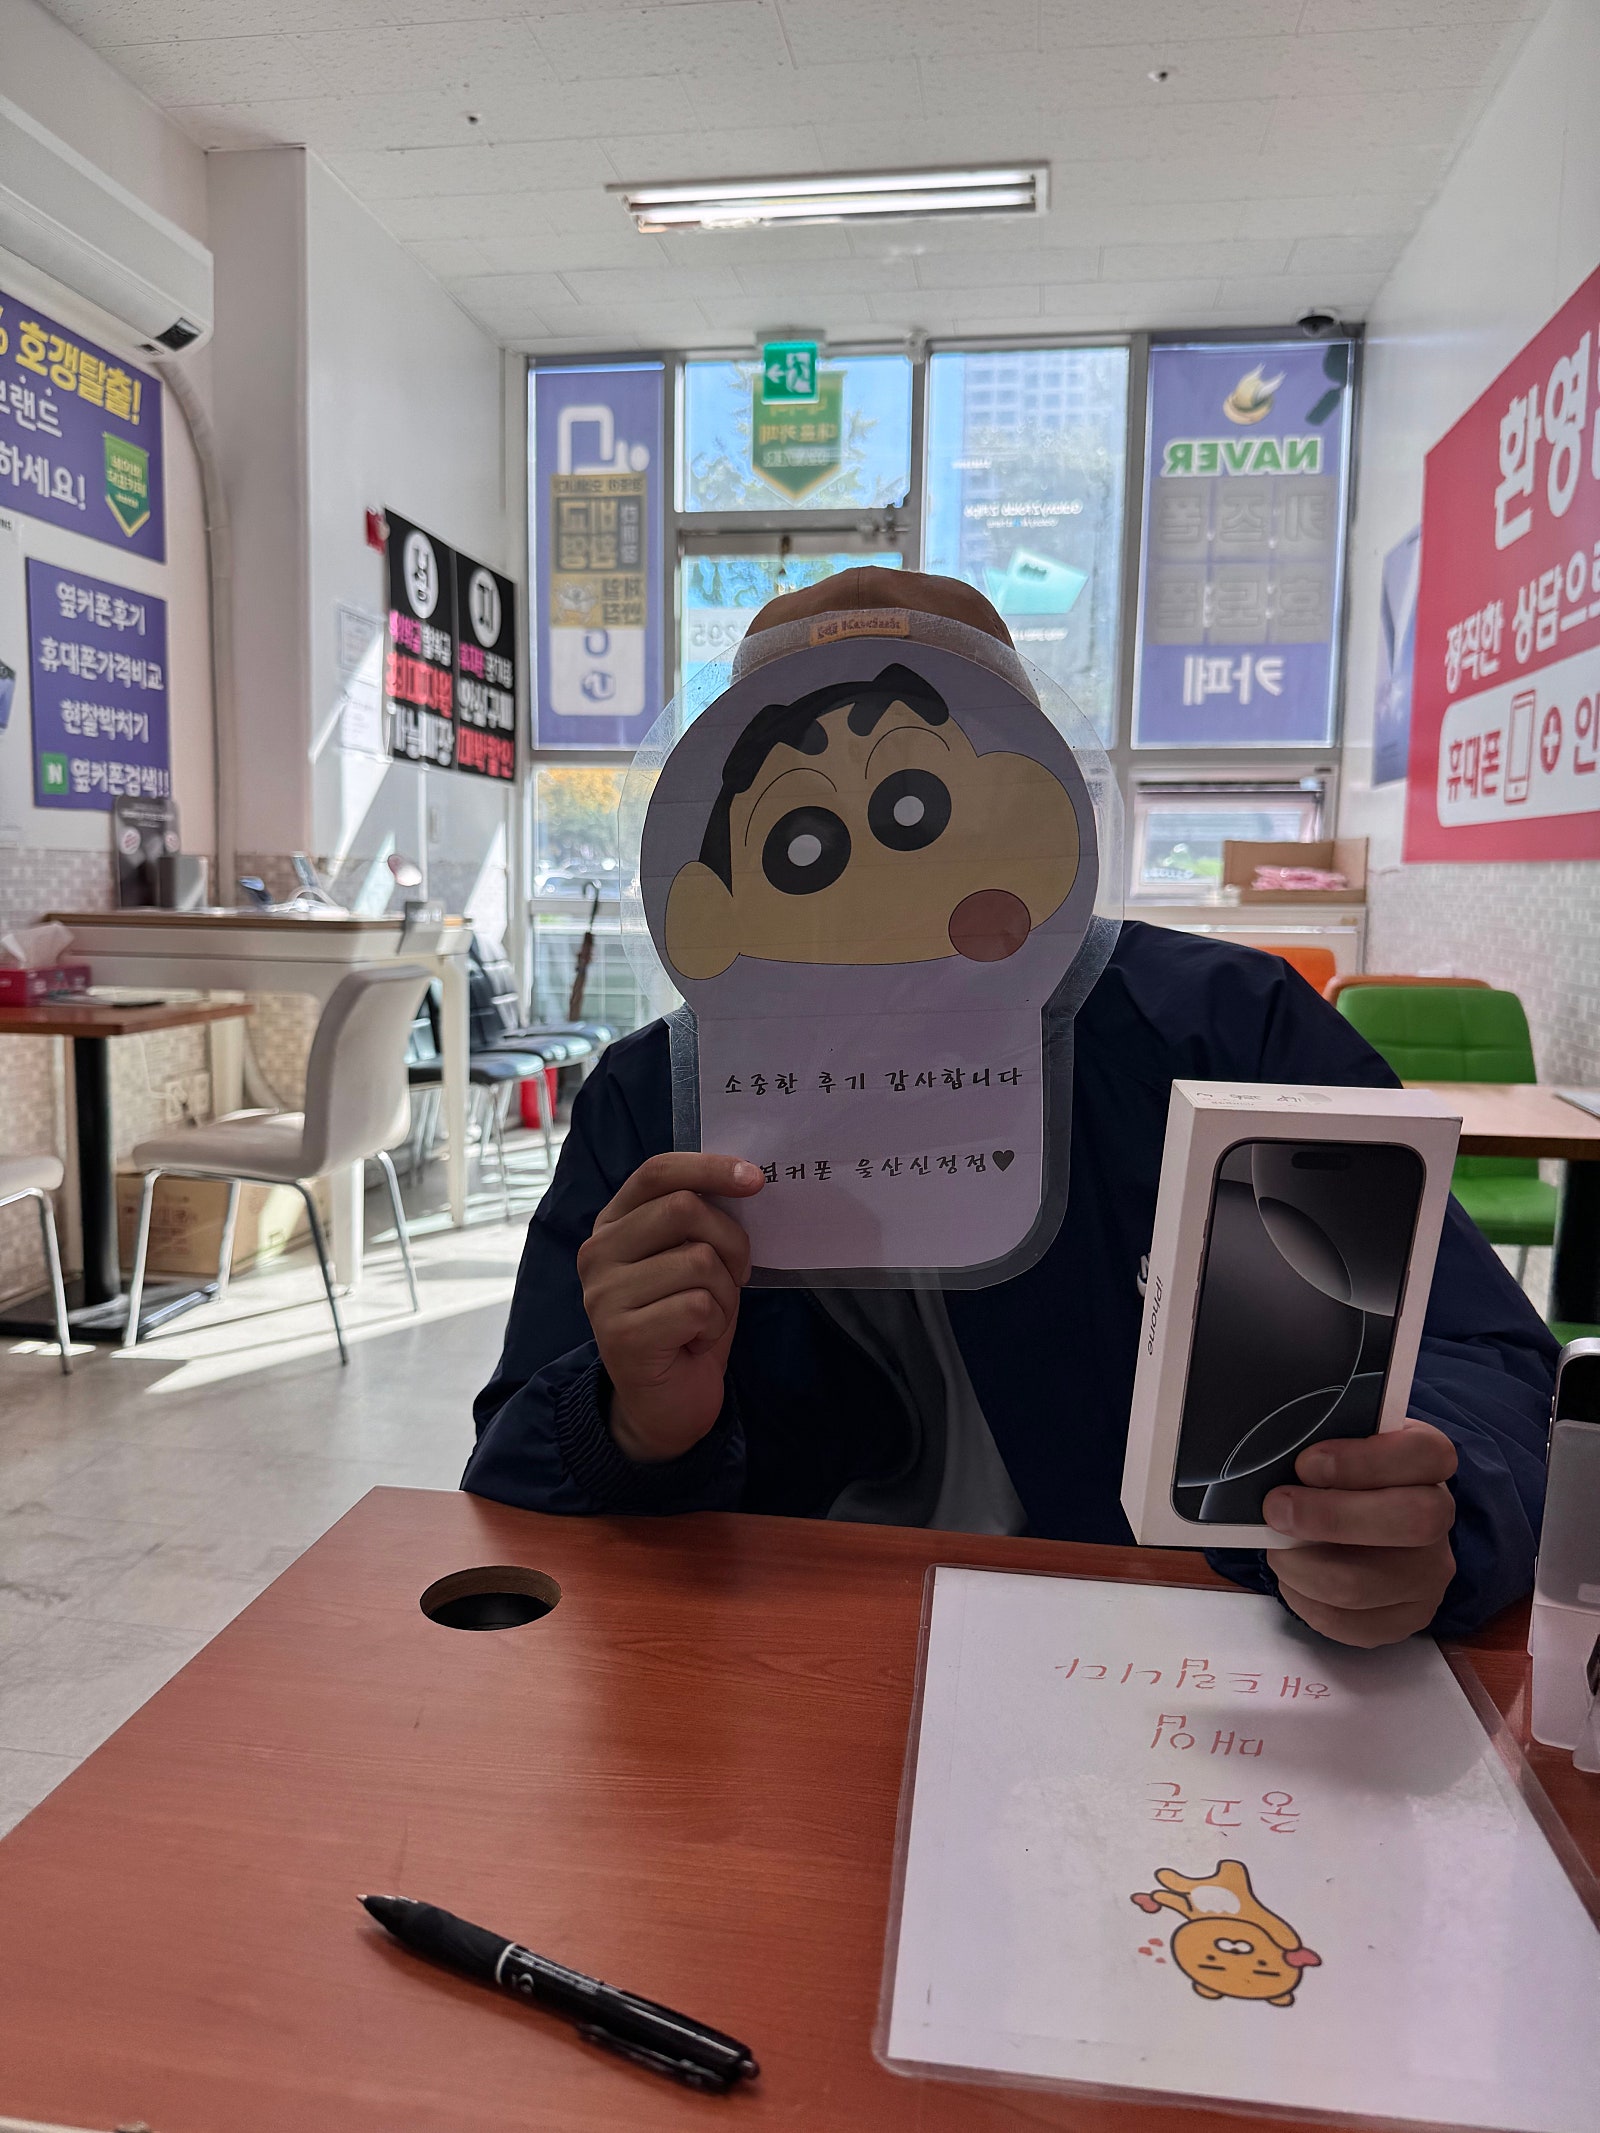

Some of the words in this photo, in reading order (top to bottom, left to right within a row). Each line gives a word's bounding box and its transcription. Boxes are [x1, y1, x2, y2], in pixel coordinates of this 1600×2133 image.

[16, 319, 142, 426] 호갱탈출!
[1494, 322, 1600, 550] 환영
[55, 580, 147, 636] 옆커폰후기
[39, 634, 165, 691] 휴대폰가격비교
[1444, 599, 1504, 694] 정직한
[61, 698, 150, 743] 현찰박치기
[69, 757, 170, 799] 옆커폰검색!!
[1447, 730, 1502, 802] 휴대폰
[725, 1072, 798, 1095] 소중한
[818, 1070, 866, 1093] 후기
[885, 1067, 1022, 1092] 감사합니다
[855, 1152, 987, 1179] 울산신정점
[1147, 1275, 1164, 1356] iPhone
[1054, 1657, 1331, 1699] 해드립니다
[1150, 1713, 1264, 1757] 매입
[1147, 1781, 1301, 1834] 중고폰
